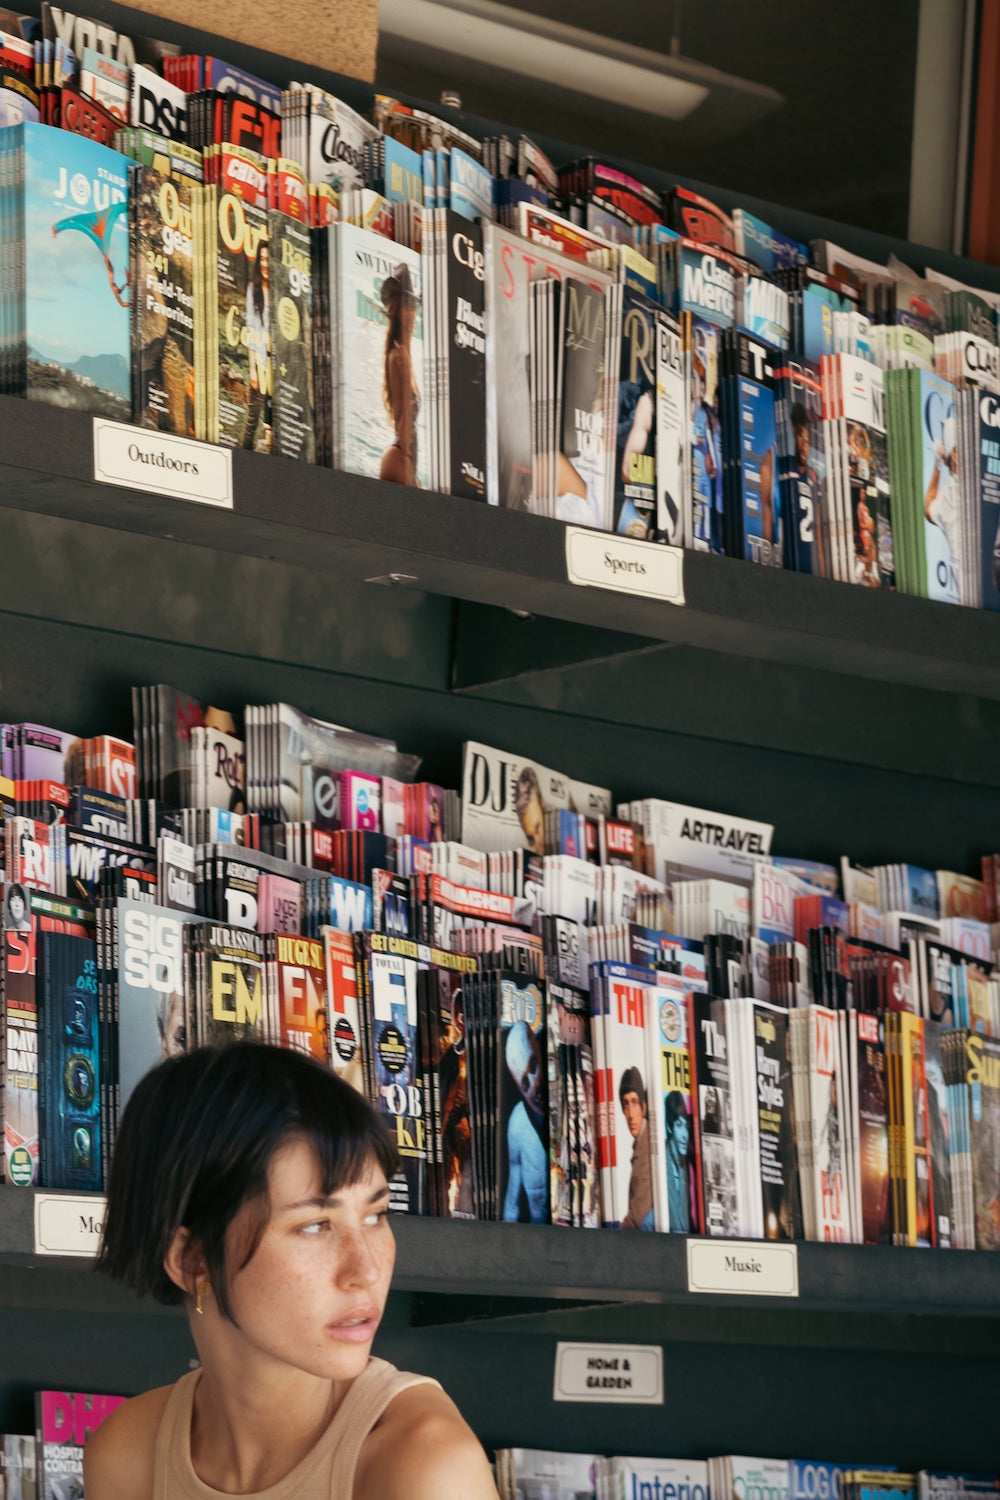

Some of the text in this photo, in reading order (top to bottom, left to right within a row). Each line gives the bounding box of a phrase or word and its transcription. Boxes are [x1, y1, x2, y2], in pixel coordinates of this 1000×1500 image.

[128, 445, 199, 476] Outdoors
[604, 552, 646, 575] Sports
[607, 823, 634, 852] LIFE
[680, 818, 765, 855] ARTRAVEL
[724, 1256, 762, 1273] Music
[587, 1358, 630, 1371] HOME &
[586, 1376, 632, 1388] GARDEN
